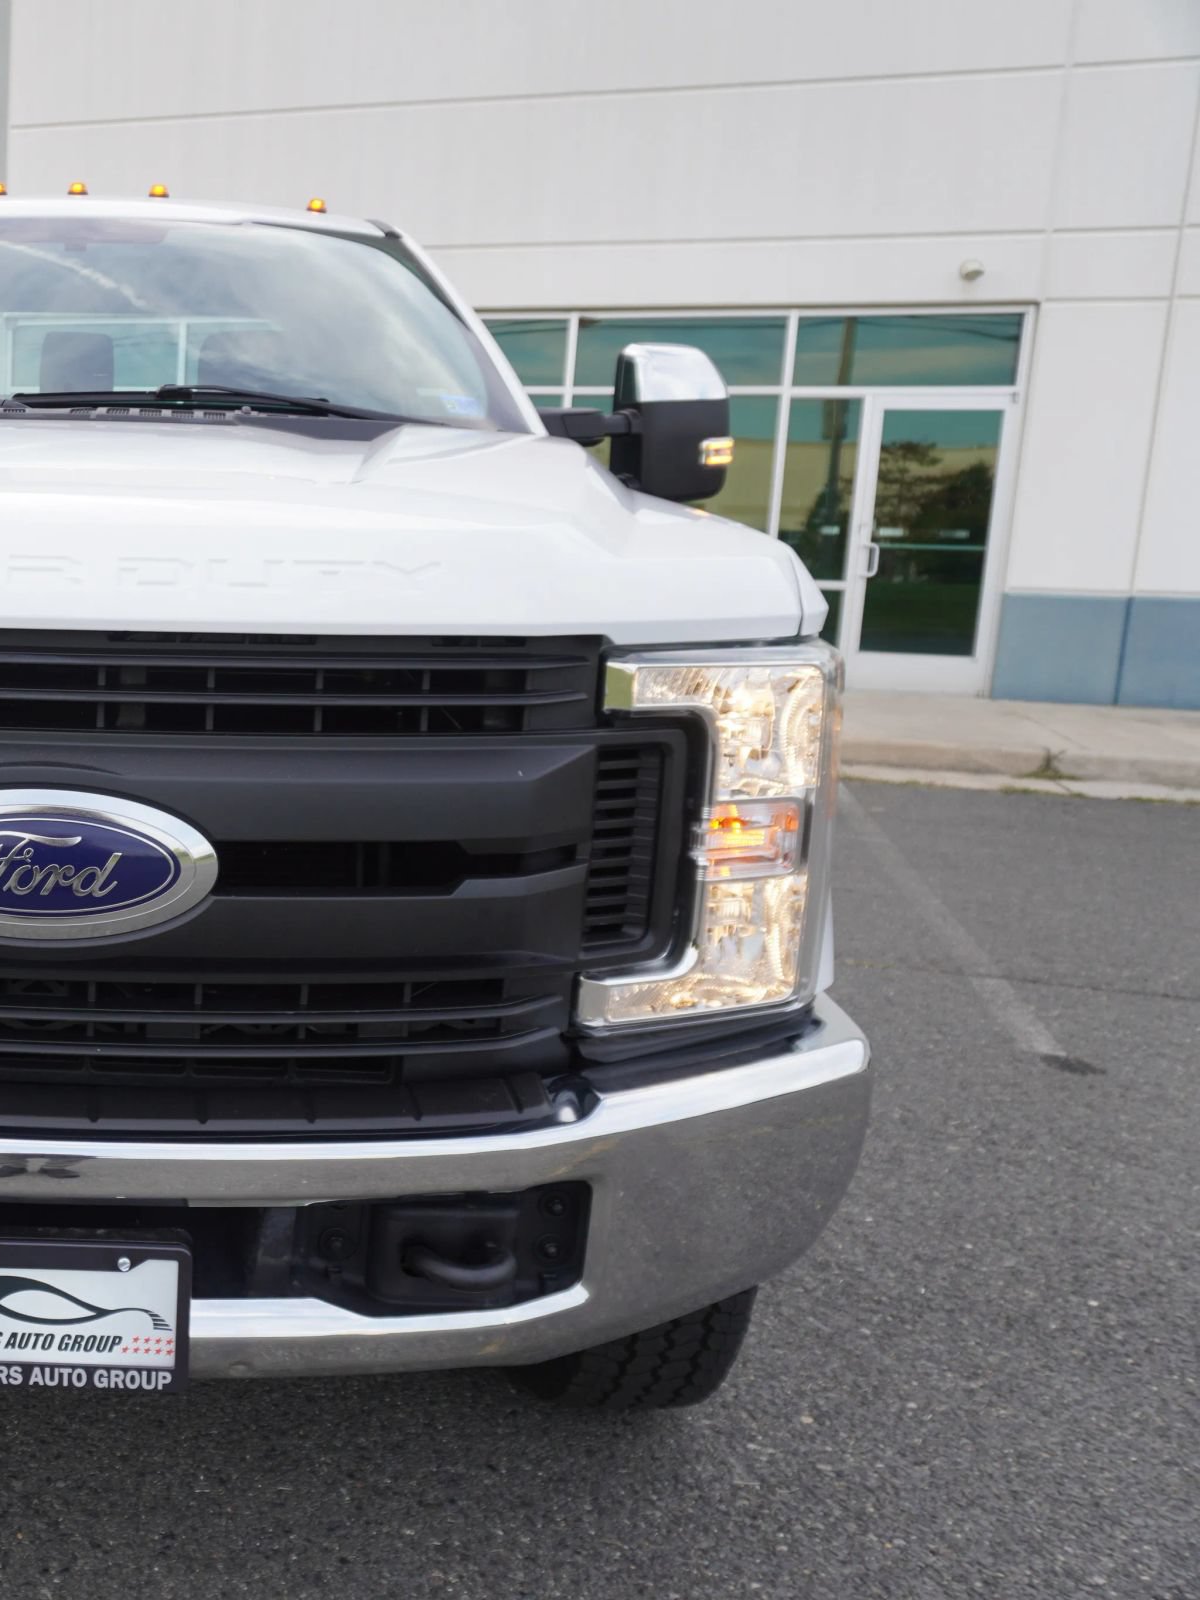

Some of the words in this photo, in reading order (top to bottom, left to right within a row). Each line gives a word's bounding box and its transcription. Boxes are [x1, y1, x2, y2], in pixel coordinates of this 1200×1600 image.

[117, 556, 442, 589] DUTY
[4, 1332, 51, 1351] AUTO
[54, 1334, 123, 1353] GROUP
[29, 1367, 87, 1387] AUTO
[93, 1369, 172, 1390] GROUP
